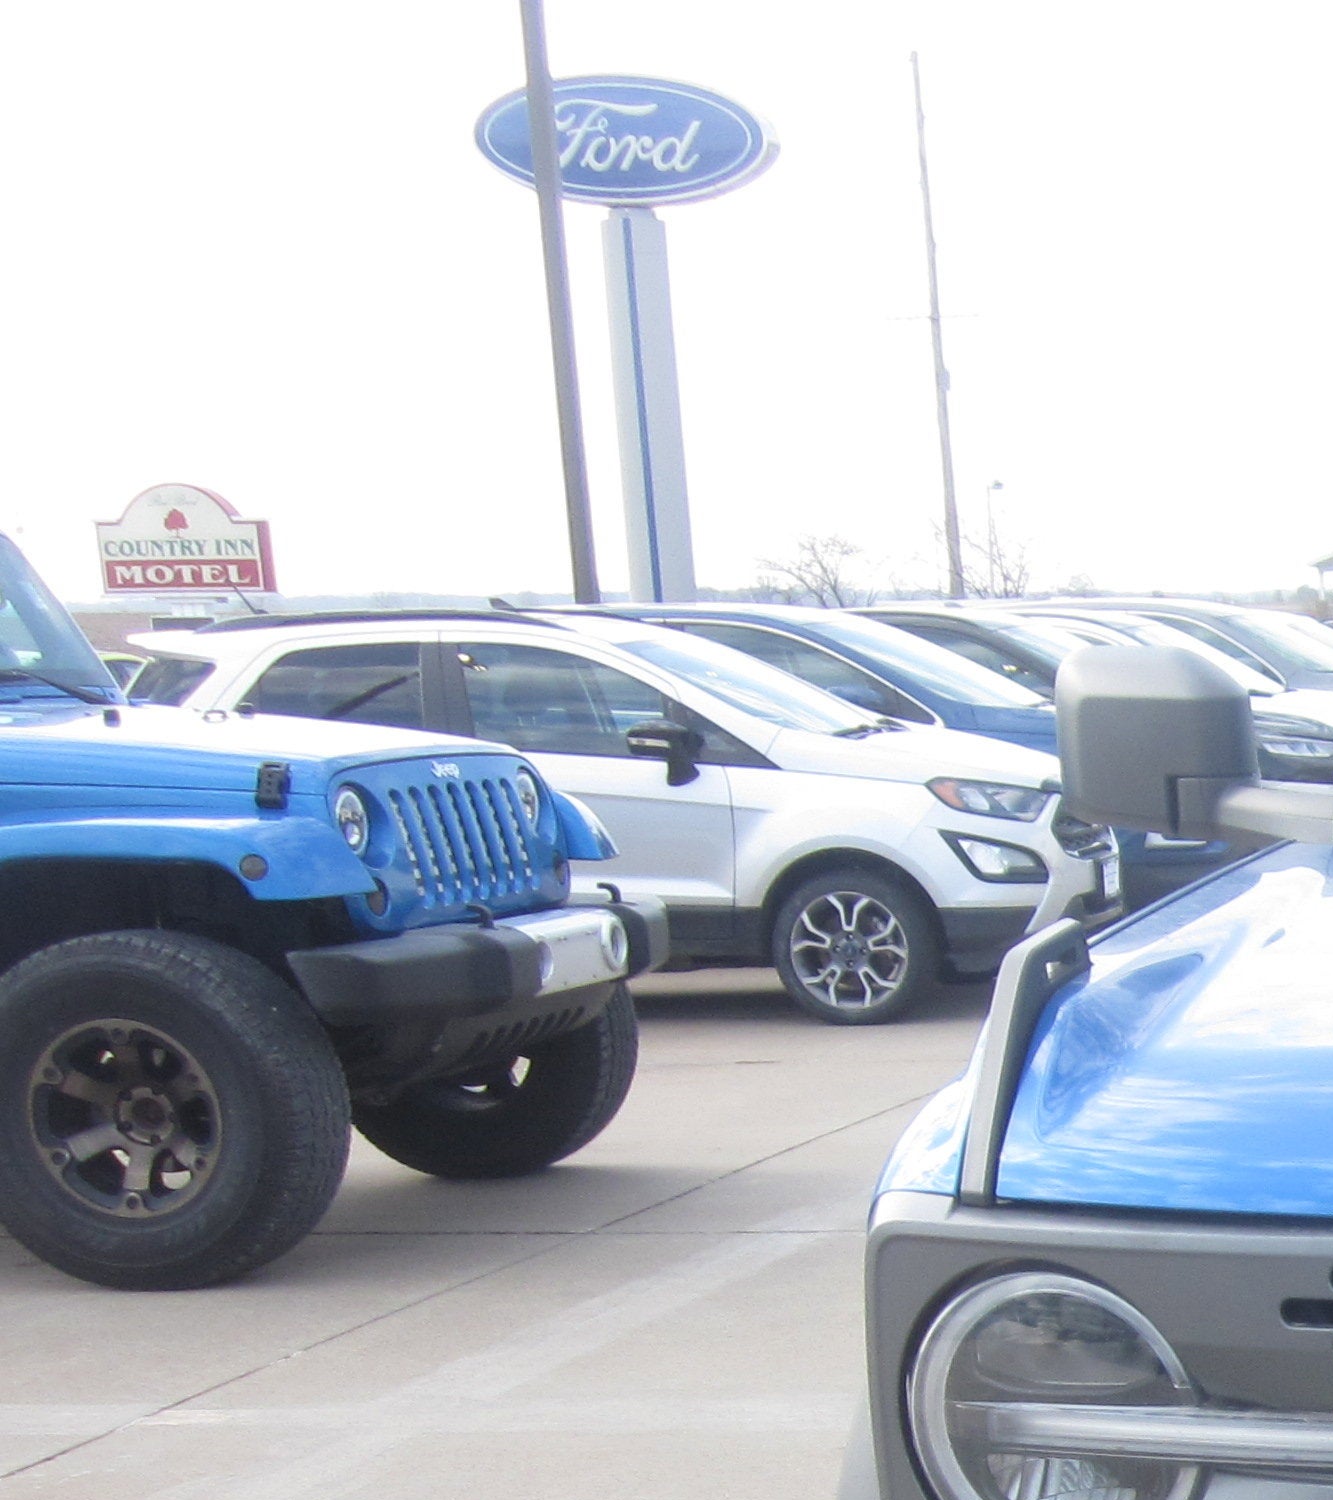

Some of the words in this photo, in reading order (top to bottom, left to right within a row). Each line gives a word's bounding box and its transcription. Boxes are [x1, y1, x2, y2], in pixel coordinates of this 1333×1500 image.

[554, 98, 701, 173] Ford
[104, 538, 207, 557] COUNTRY
[214, 538, 257, 557] INN
[113, 564, 251, 585] MOTEL
[430, 760, 460, 779] Jeep
